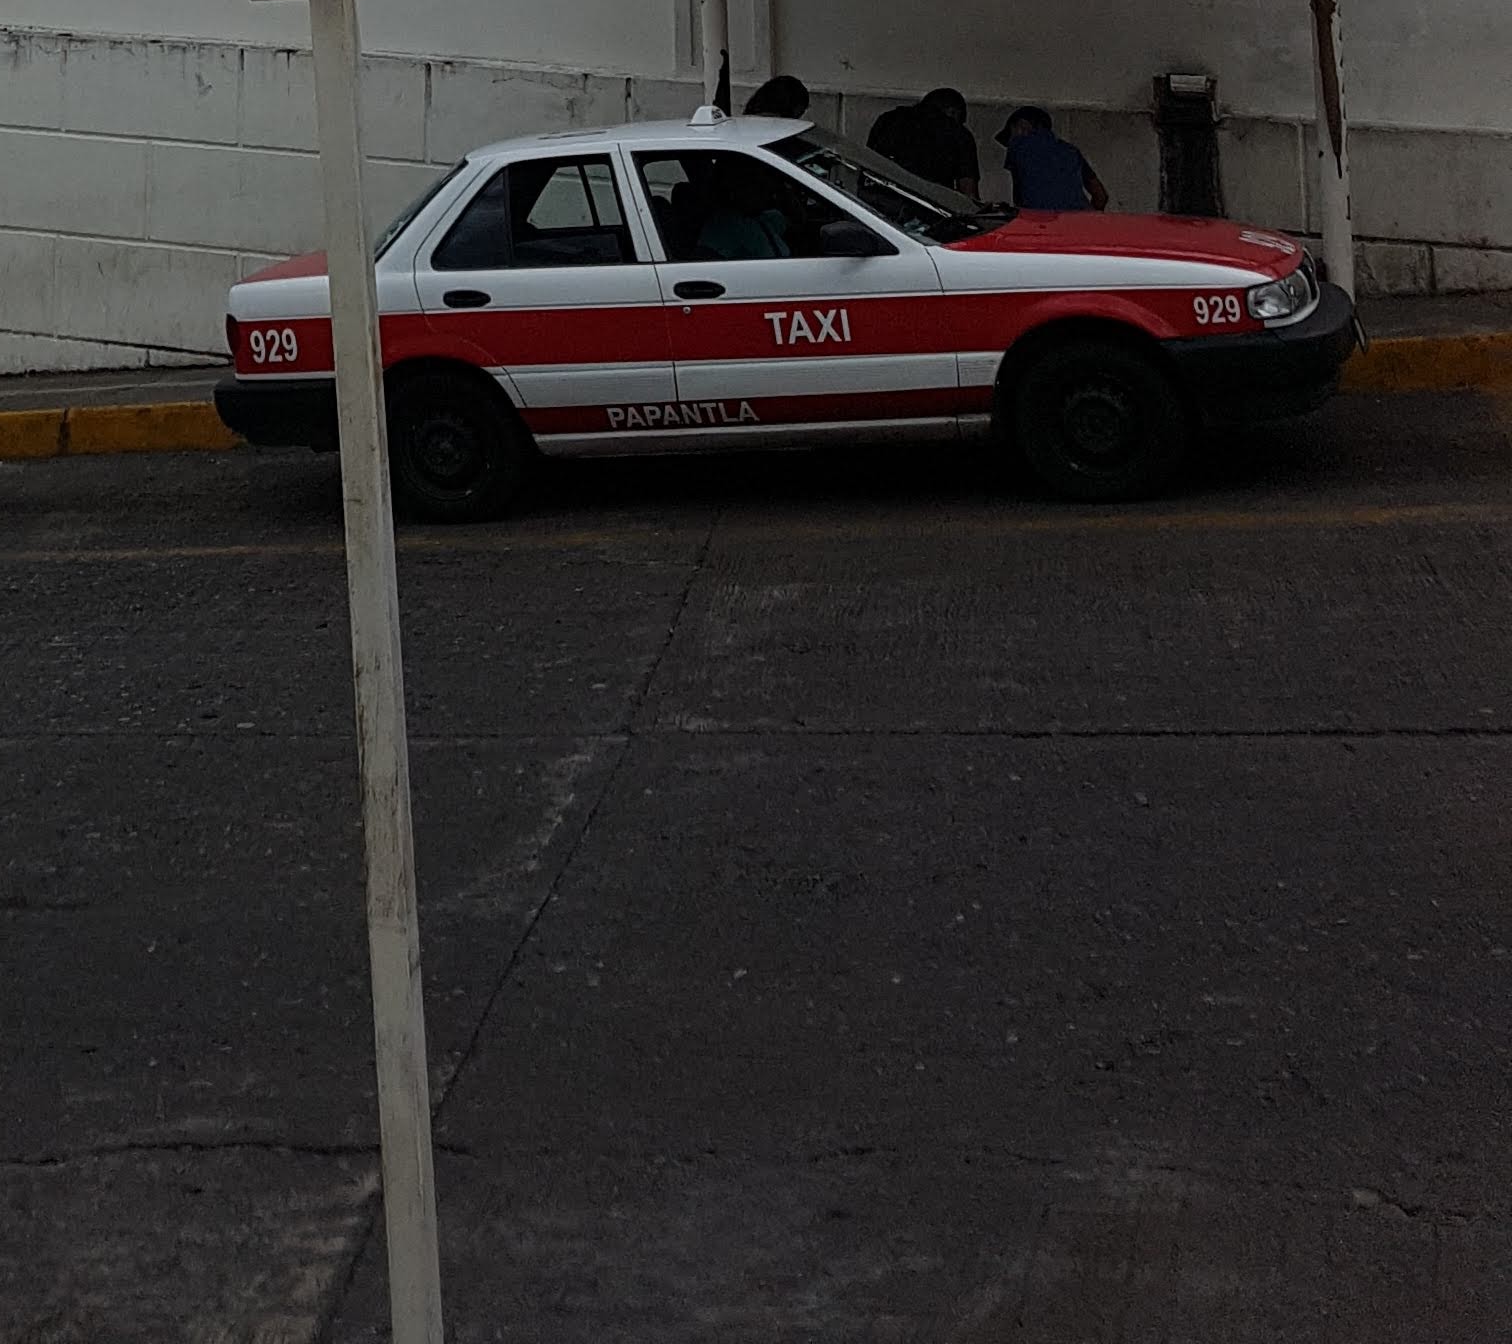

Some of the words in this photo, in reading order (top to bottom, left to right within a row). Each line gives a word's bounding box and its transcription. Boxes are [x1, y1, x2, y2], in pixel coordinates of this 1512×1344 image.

[764, 308, 852, 345] TAXI
[1193, 294, 1241, 325] 929
[249, 327, 298, 364] 929
[606, 400, 761, 429] PAPANTLA
